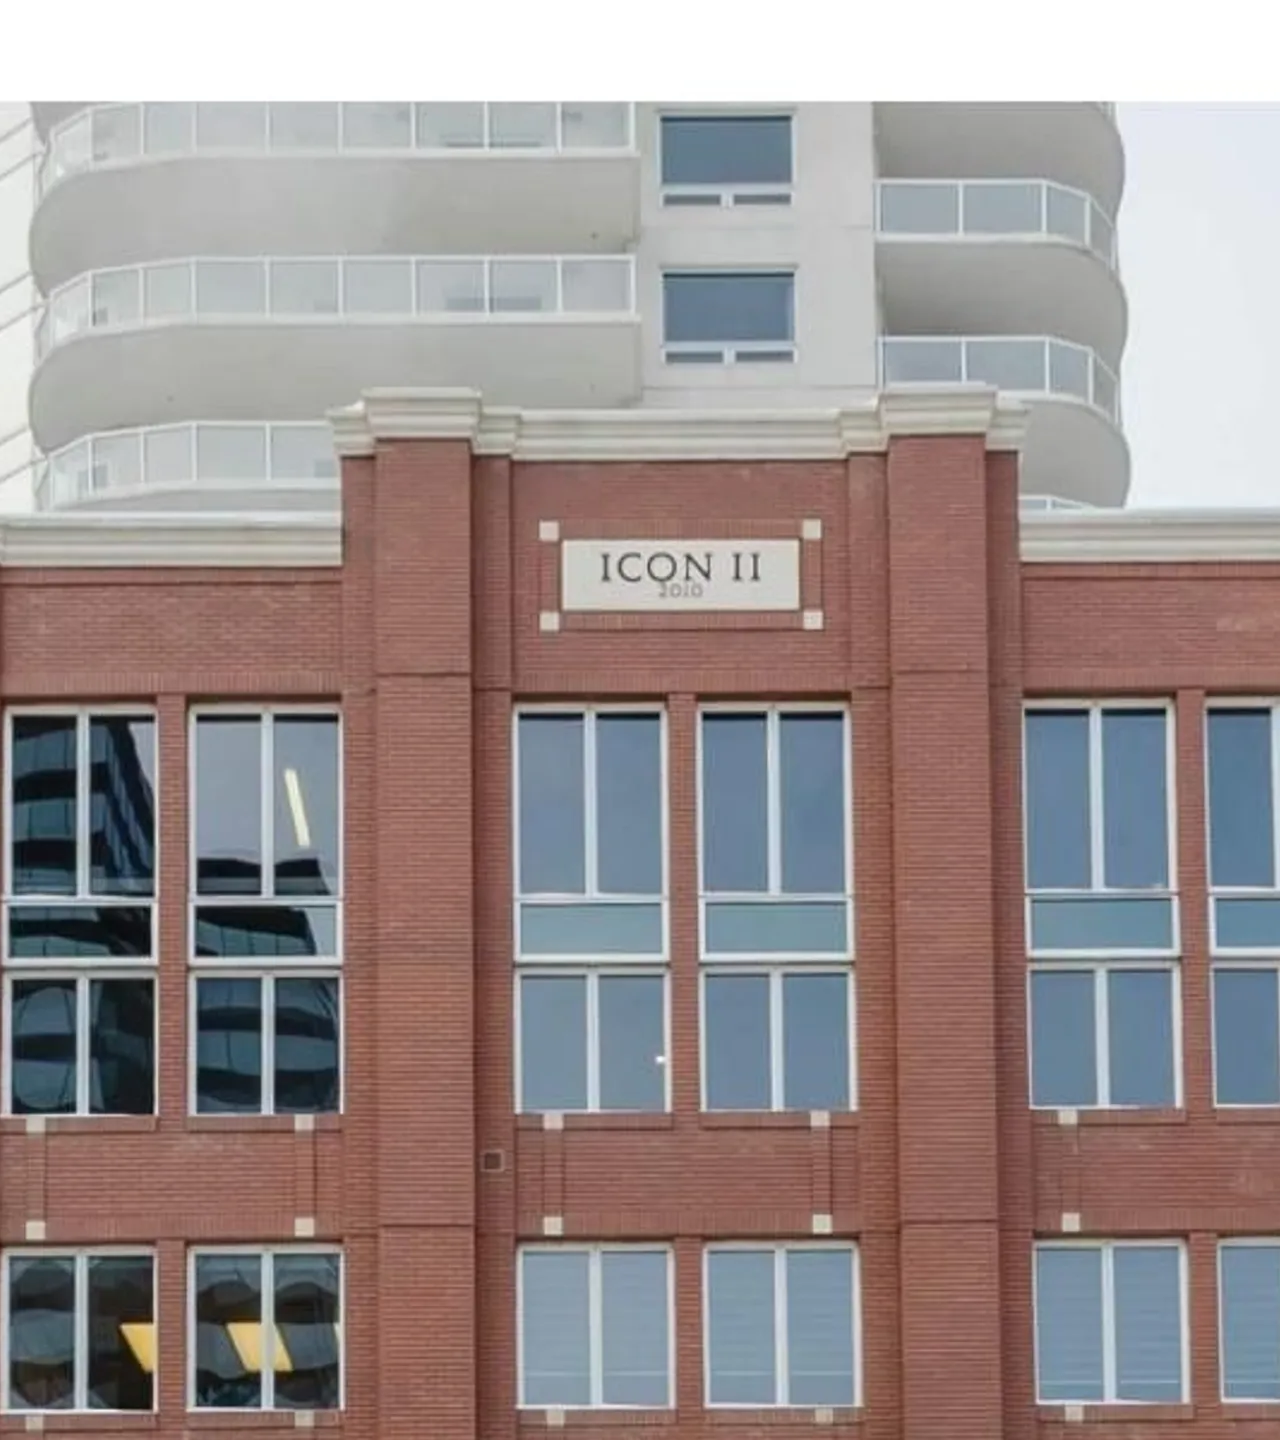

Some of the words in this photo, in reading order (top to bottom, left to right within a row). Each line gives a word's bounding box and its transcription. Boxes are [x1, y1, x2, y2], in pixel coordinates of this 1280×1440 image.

[600, 553, 713, 584] ICON
[732, 553, 760, 582] II
[658, 583, 703, 598] 2010
